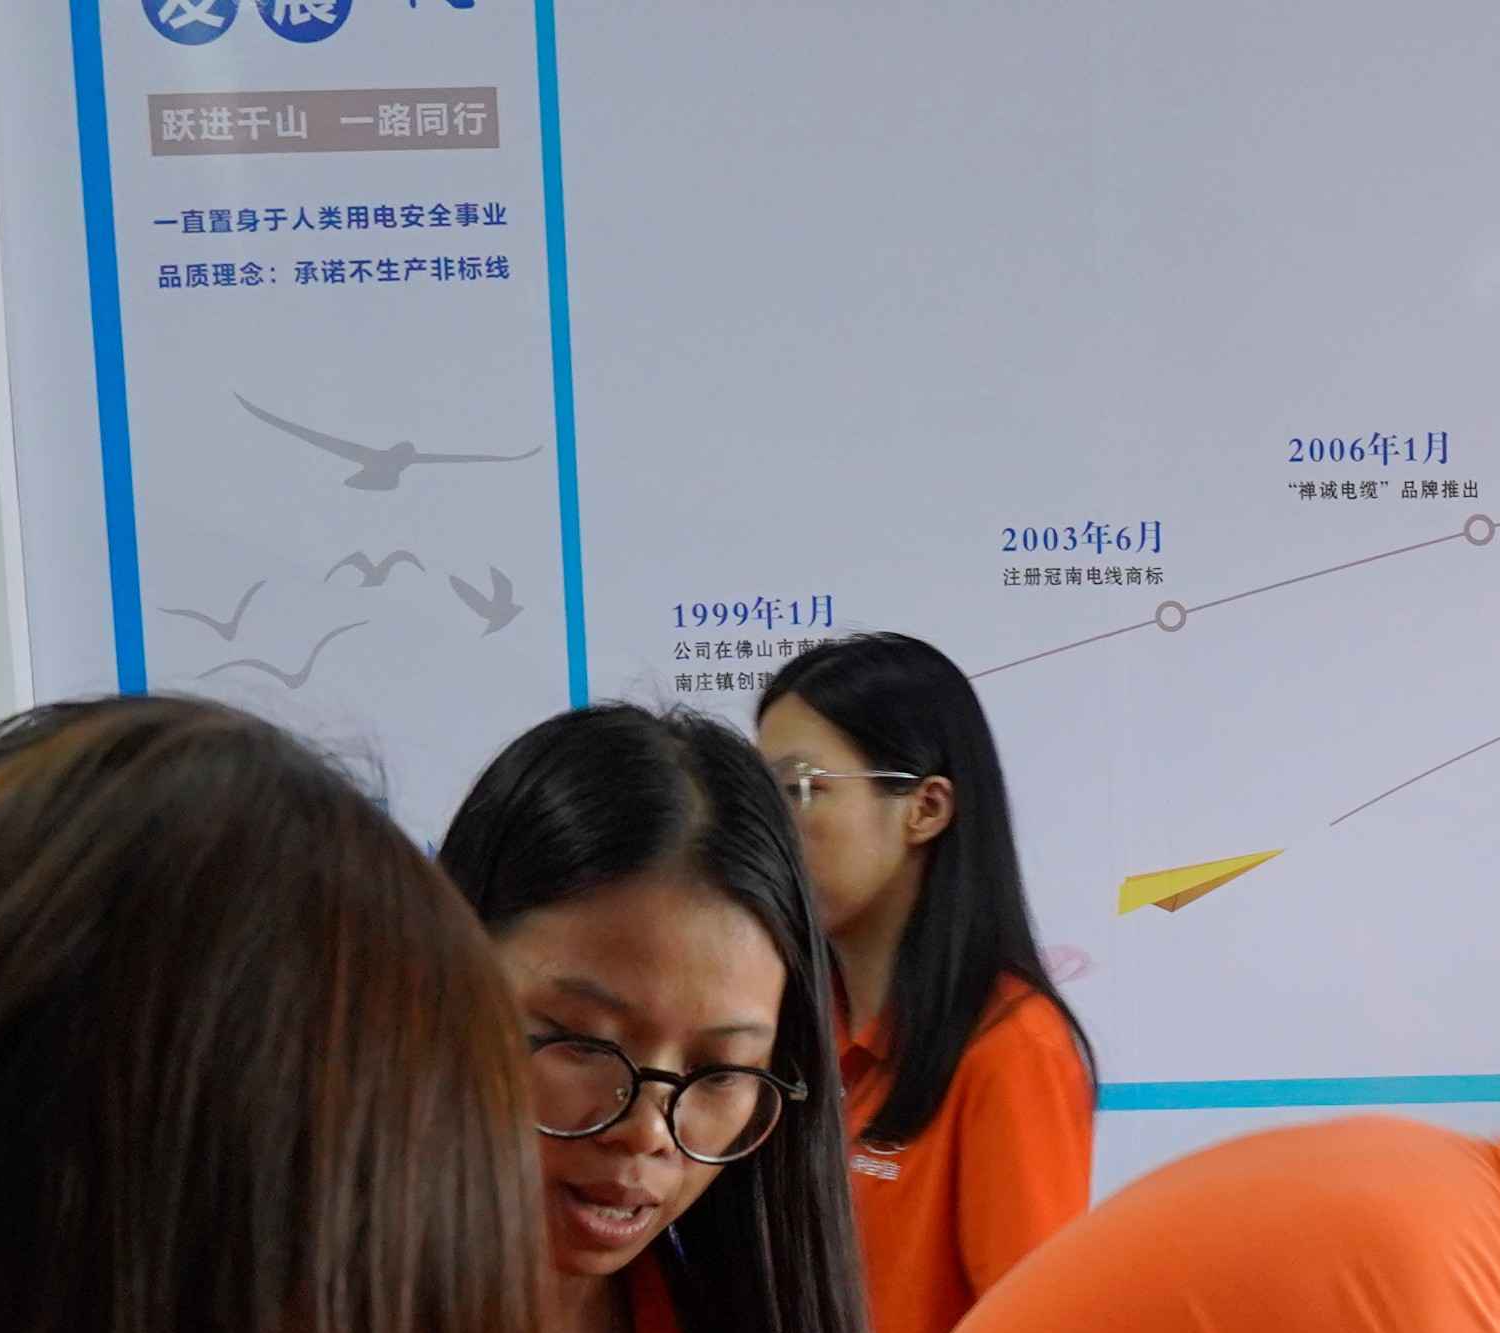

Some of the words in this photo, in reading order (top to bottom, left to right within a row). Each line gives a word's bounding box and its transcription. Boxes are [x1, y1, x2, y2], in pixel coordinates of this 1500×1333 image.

[161, 104, 308, 142] 跃进千山
[339, 102, 487, 137] 一路同行
[153, 202, 507, 236] 一直置身于人类用电安全事业
[158, 256, 510, 289] 品质理念：承诺不生产非标线
[1288, 431, 1451, 466] 2006年1月
[1002, 520, 1163, 555] 2003年6月
[1003, 565, 1163, 587] 注册冠南电线商标
[673, 594, 833, 630] 1999年1月
